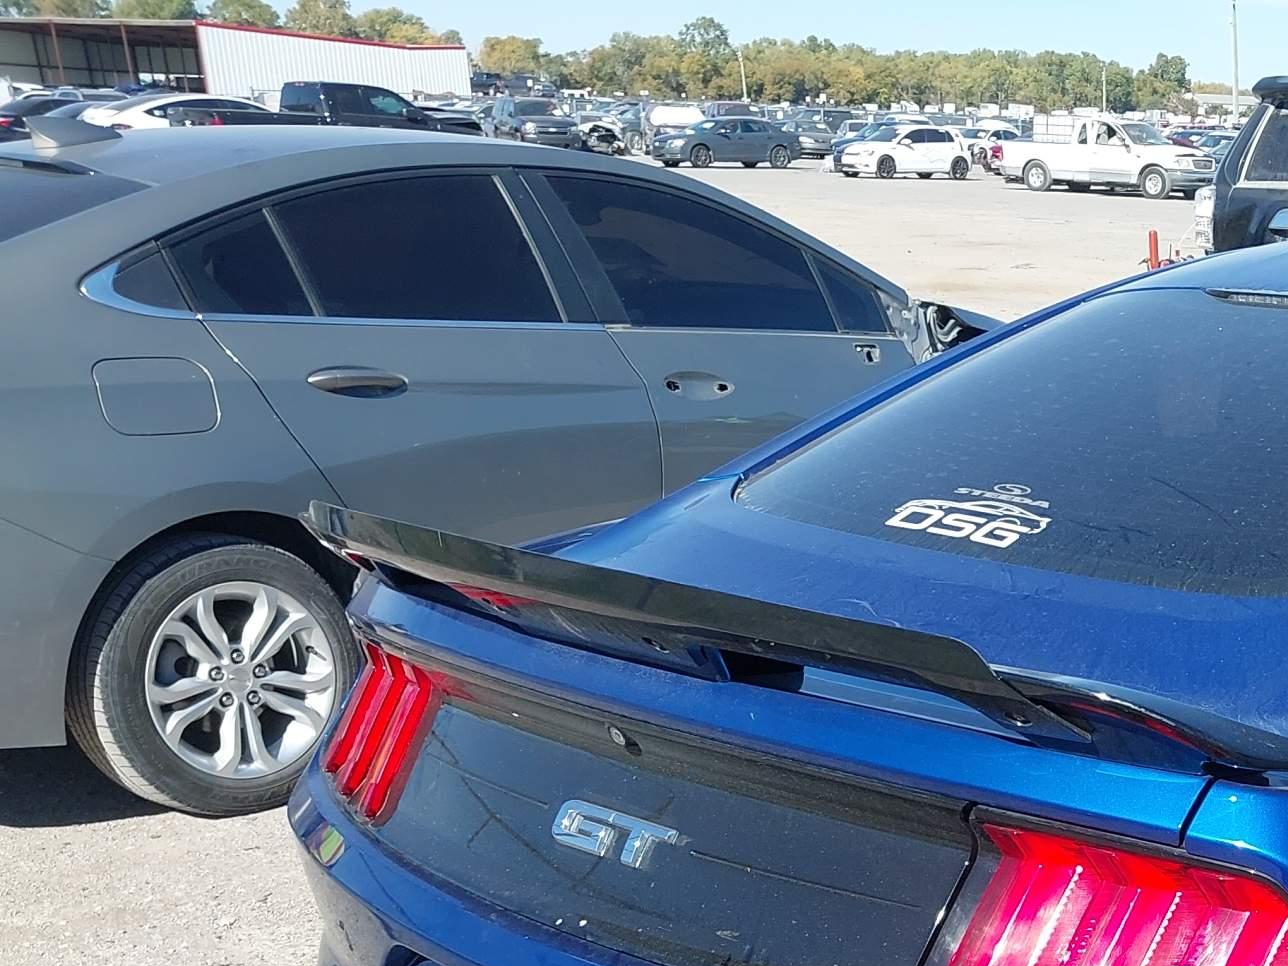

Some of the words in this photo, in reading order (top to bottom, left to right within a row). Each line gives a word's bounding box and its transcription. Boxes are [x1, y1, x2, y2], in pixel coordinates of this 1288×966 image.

[953, 487, 1051, 509] STEEDA
[884, 505, 1032, 550] DSG
[551, 799, 680, 870] GT
